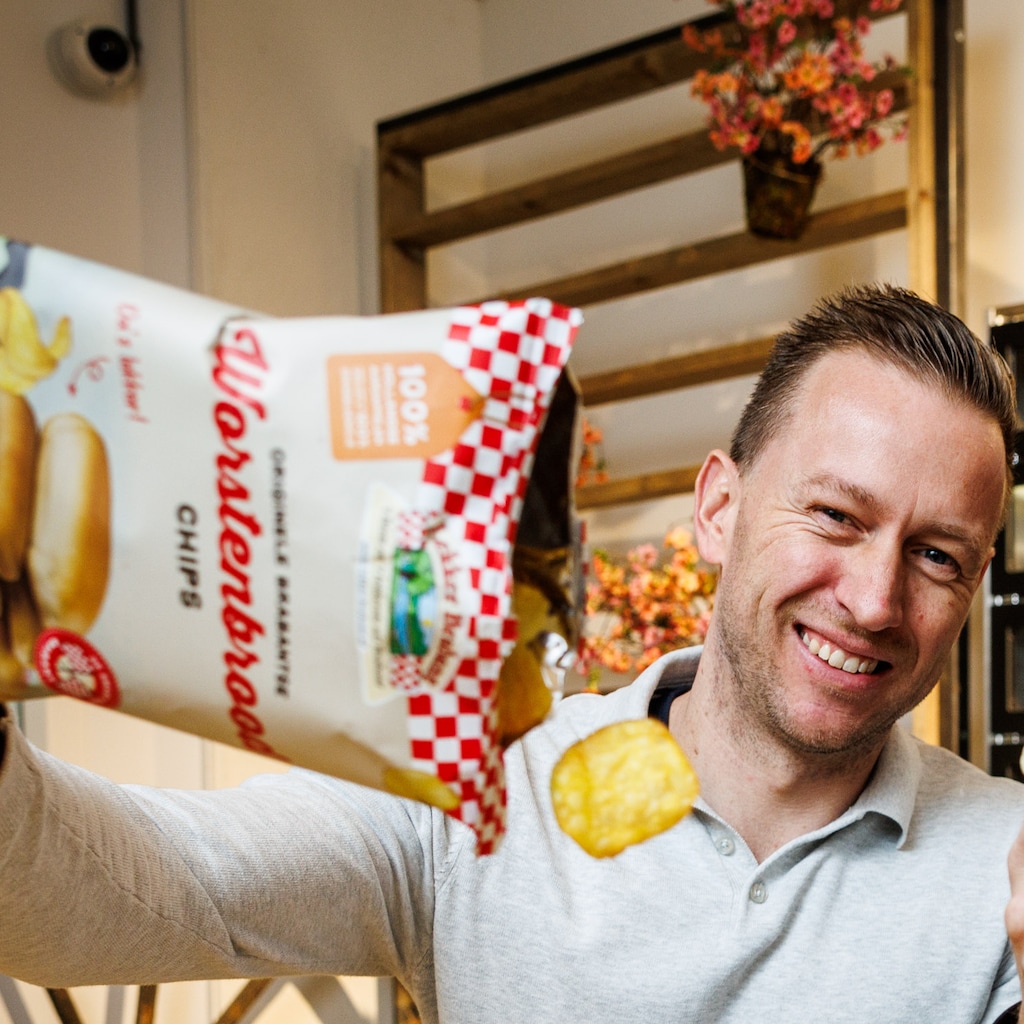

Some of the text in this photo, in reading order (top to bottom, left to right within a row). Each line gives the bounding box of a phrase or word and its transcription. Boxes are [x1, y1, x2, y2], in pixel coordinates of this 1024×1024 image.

[398, 363, 428, 446] 100%
[174, 504, 203, 609] CHIPS
[271, 448, 290, 568] ORIGINELE
